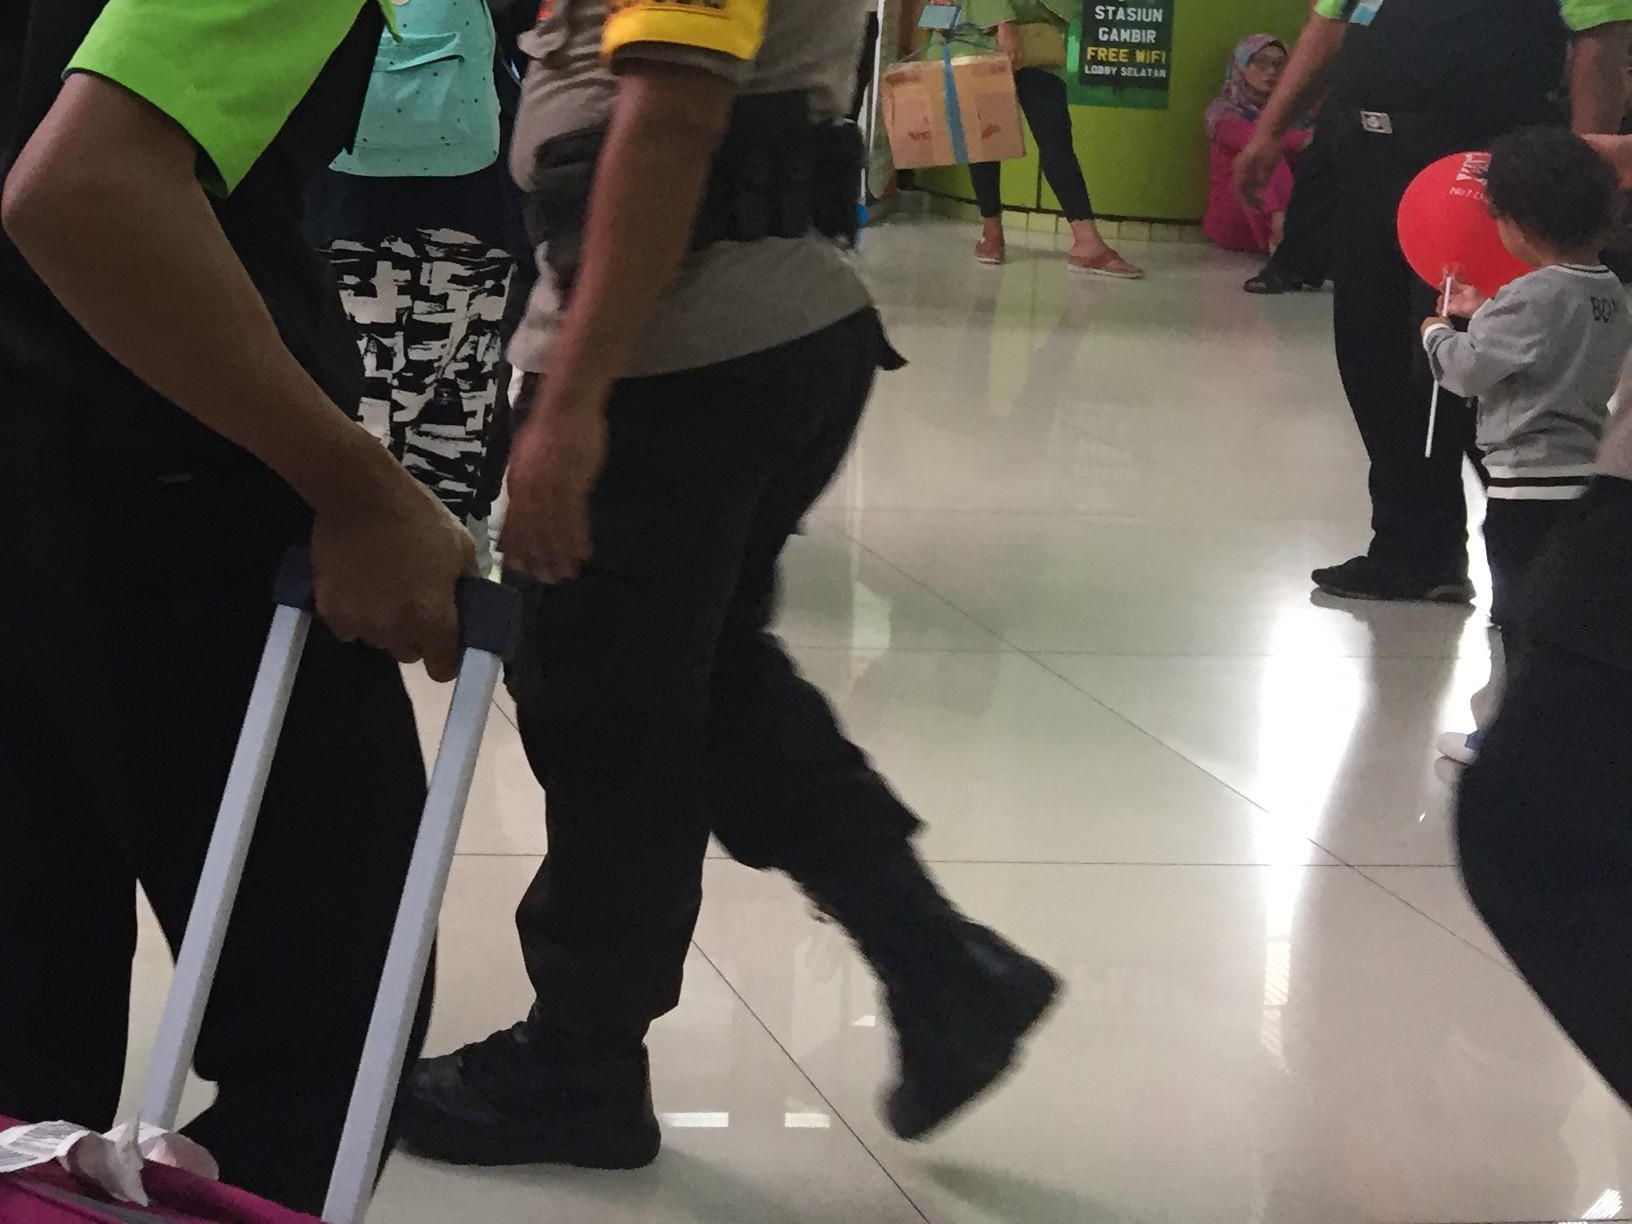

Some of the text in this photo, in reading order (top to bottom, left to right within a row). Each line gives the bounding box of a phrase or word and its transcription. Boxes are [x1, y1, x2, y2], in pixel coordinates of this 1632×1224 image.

[1094, 4, 1164, 24] STASIUN
[1098, 26, 1158, 44] GAMBIR
[1086, 46, 1167, 64] FREE WIFI
[1084, 64, 1167, 78] LOBBY SELATAN
